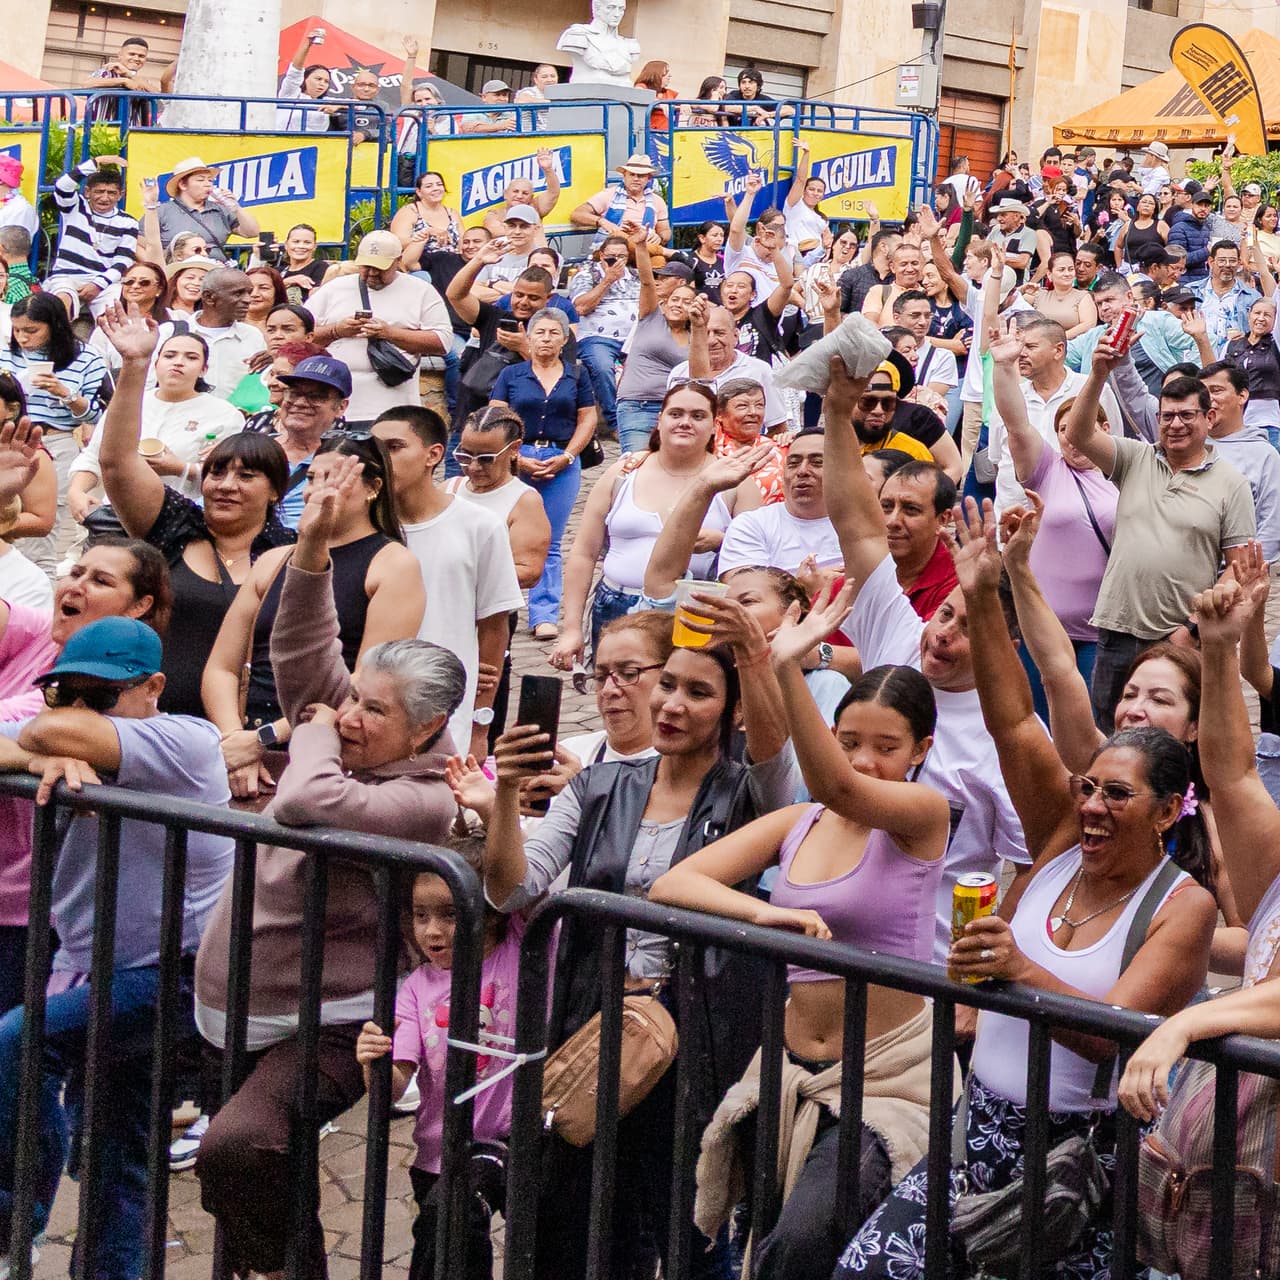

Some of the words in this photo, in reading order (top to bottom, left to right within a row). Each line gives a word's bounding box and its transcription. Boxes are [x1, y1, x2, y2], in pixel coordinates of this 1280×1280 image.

[1198, 61, 1253, 118] REAL
[819, 150, 892, 194] AGUILA
[840, 199, 864, 211] 1913
